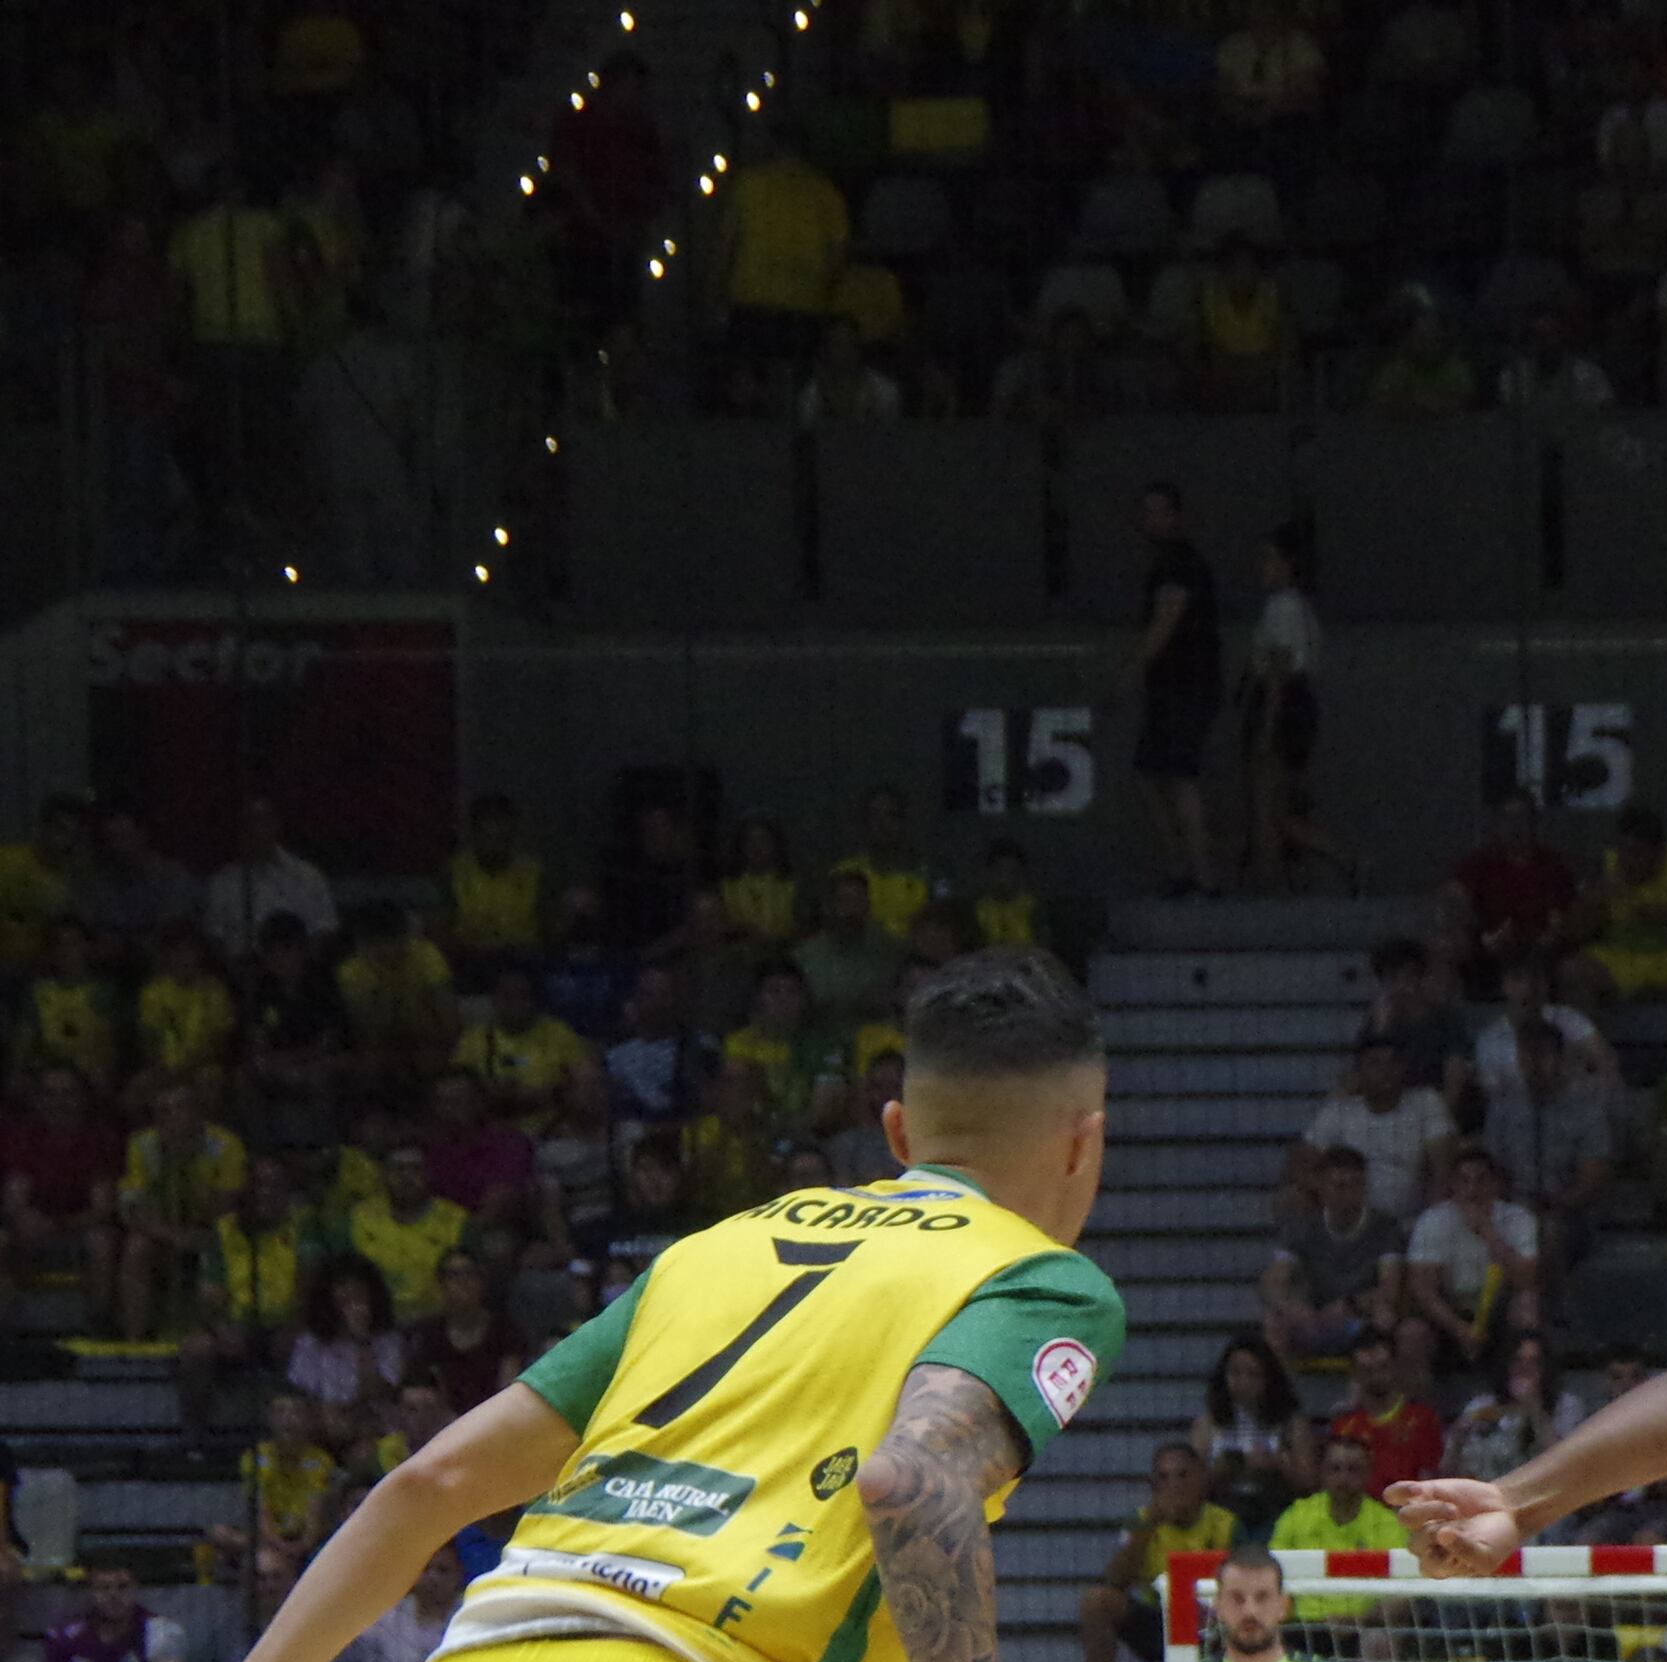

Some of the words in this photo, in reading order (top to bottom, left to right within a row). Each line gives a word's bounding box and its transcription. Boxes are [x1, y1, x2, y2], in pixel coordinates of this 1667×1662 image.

[92, 622, 322, 685] Sector
[958, 706, 1094, 815] 15
[1496, 702, 1634, 812] 15
[633, 1236, 866, 1428] 7
